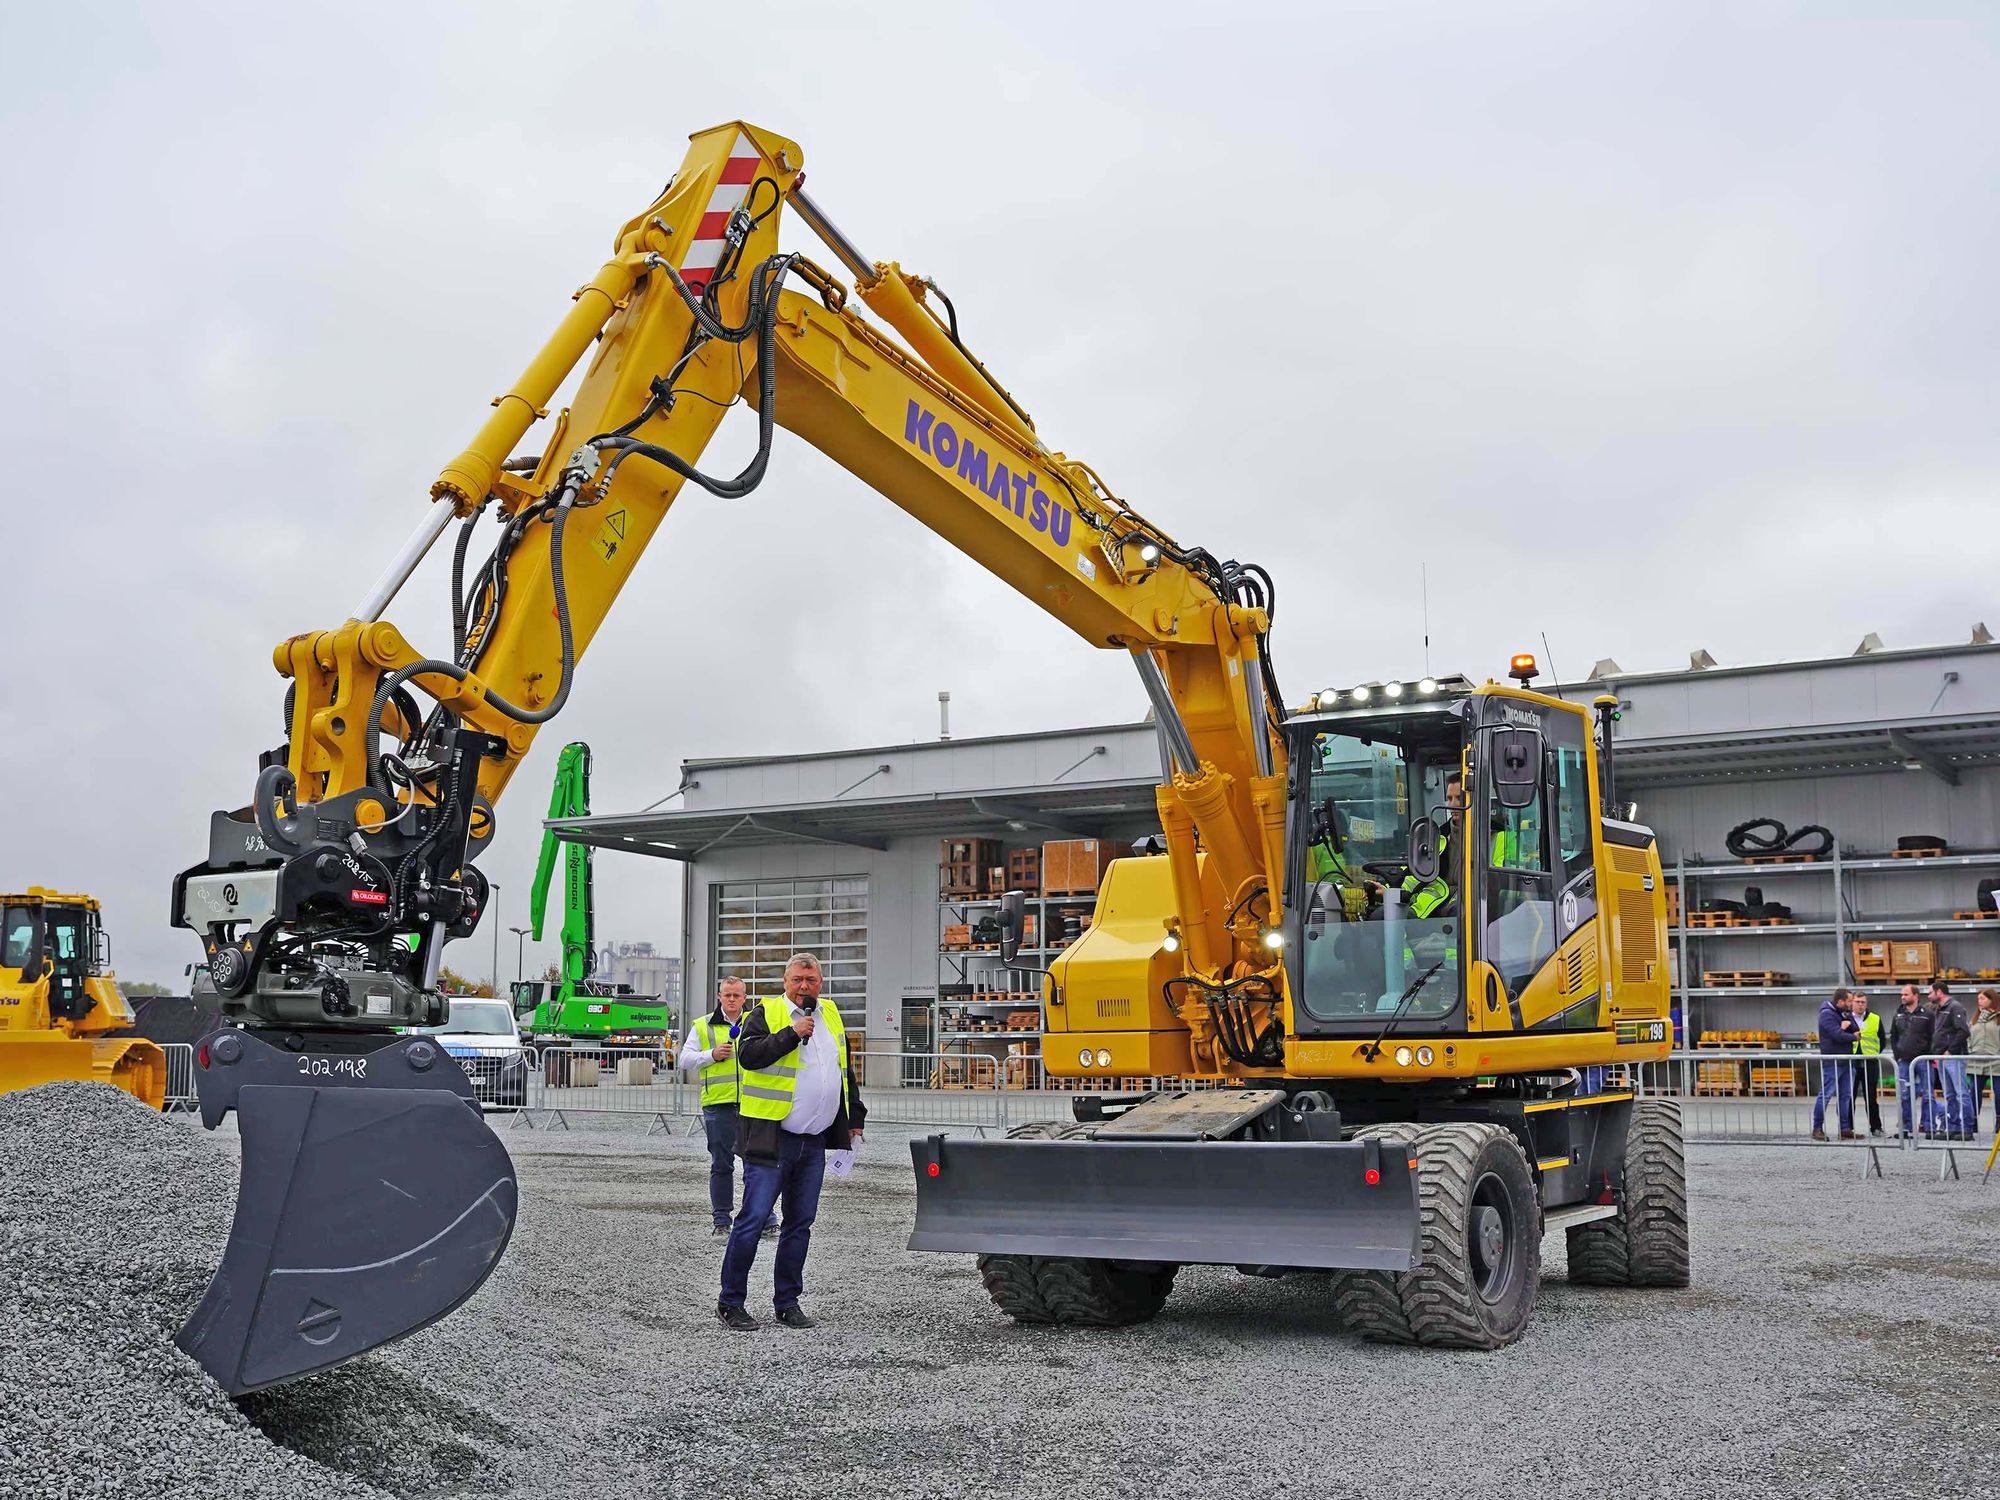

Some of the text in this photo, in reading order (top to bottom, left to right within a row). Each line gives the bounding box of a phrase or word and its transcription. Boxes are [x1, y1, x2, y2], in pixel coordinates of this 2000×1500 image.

[905, 398, 1072, 547] KOMATSU
[1507, 707, 1541, 728] KOMATSU
[1566, 898, 1576, 923] 20
[297, 1055, 367, 1079] 202198
